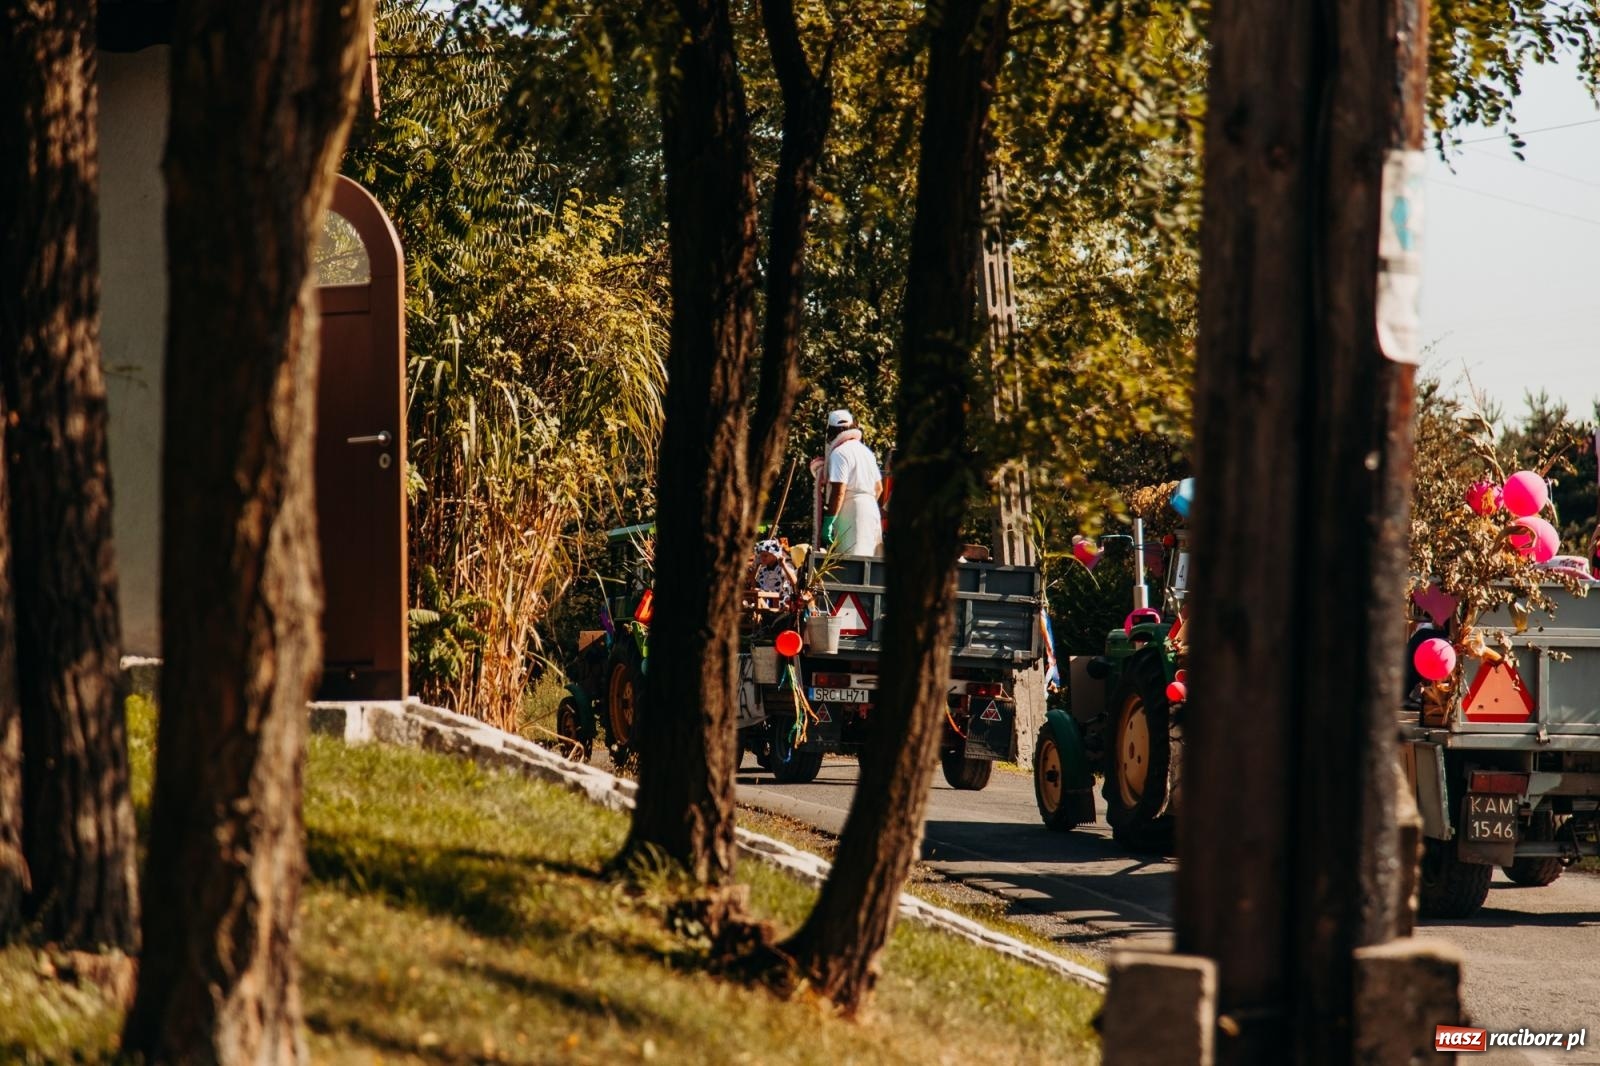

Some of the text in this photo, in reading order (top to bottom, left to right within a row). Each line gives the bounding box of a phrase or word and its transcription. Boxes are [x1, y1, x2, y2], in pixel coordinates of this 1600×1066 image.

[815, 689, 865, 702] SRC LH71
[1471, 797, 1513, 815] KAM
[1473, 821, 1513, 839] 1546
